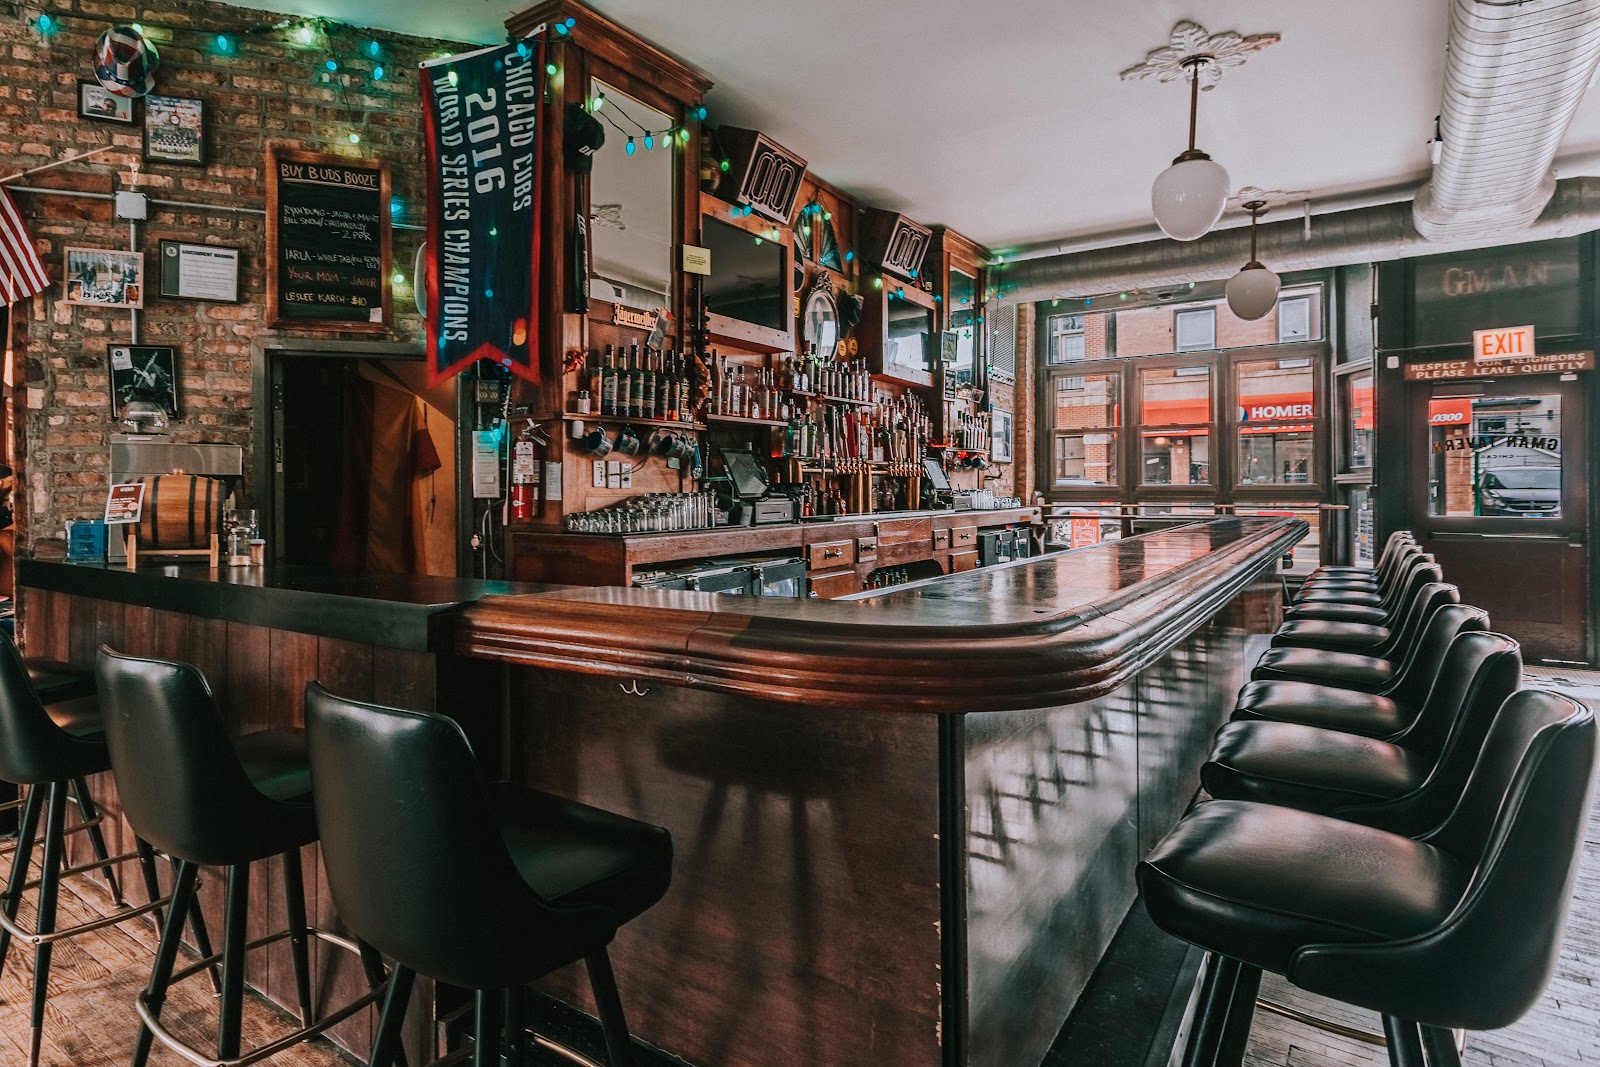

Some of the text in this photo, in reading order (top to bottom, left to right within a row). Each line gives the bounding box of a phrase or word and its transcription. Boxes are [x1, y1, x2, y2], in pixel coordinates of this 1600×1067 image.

[465, 87, 506, 194] 2016
[504, 49, 535, 212] CHICAGO CUBS
[281, 163, 377, 187] BUY BUDS BOOZE
[433, 74, 472, 342] WORLD SERIES CHAMPIONS
[316, 272, 339, 283] MOM
[1482, 331, 1525, 356] EXIT
[1411, 361, 1467, 372] RESPECT
[1510, 353, 1585, 364] NEIGHBORS
[1416, 361, 1586, 379] PLEASE LEAVE QUIETLY
[1251, 404, 1312, 418] HOMER
